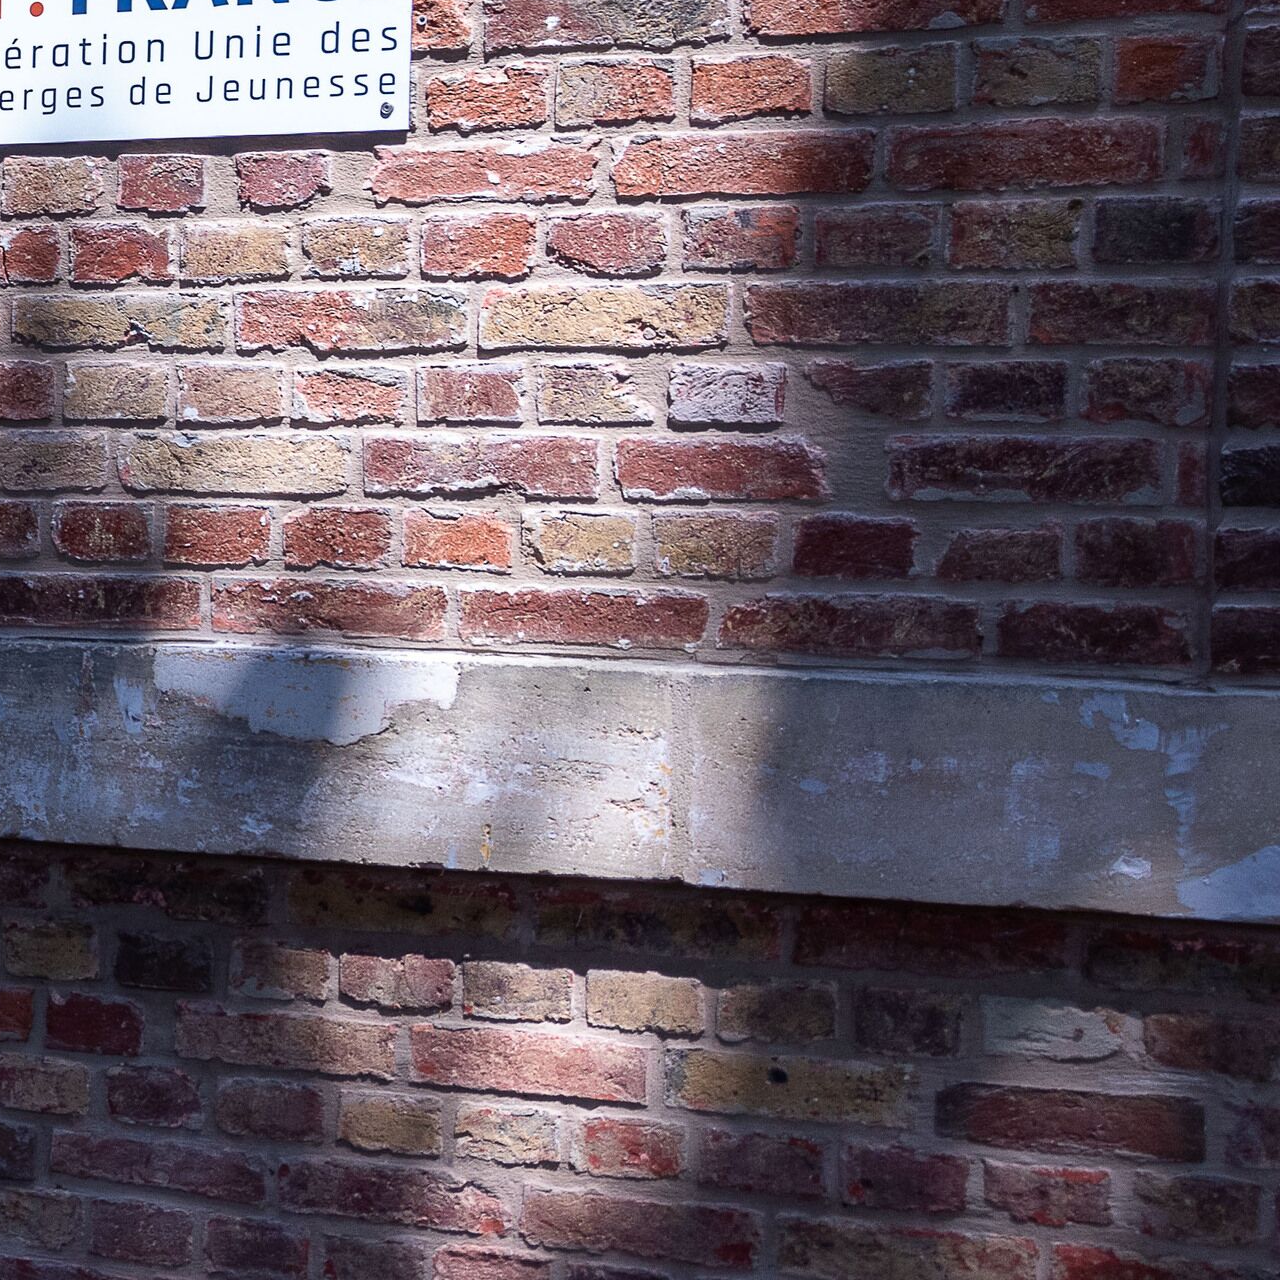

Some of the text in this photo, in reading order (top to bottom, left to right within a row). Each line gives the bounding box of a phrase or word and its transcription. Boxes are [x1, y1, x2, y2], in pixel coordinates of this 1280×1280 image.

[195, 26, 290, 60] Unie
[321, 21, 397, 53] des
[130, 77, 171, 105] de
[197, 73, 395, 102] Jeunesse
